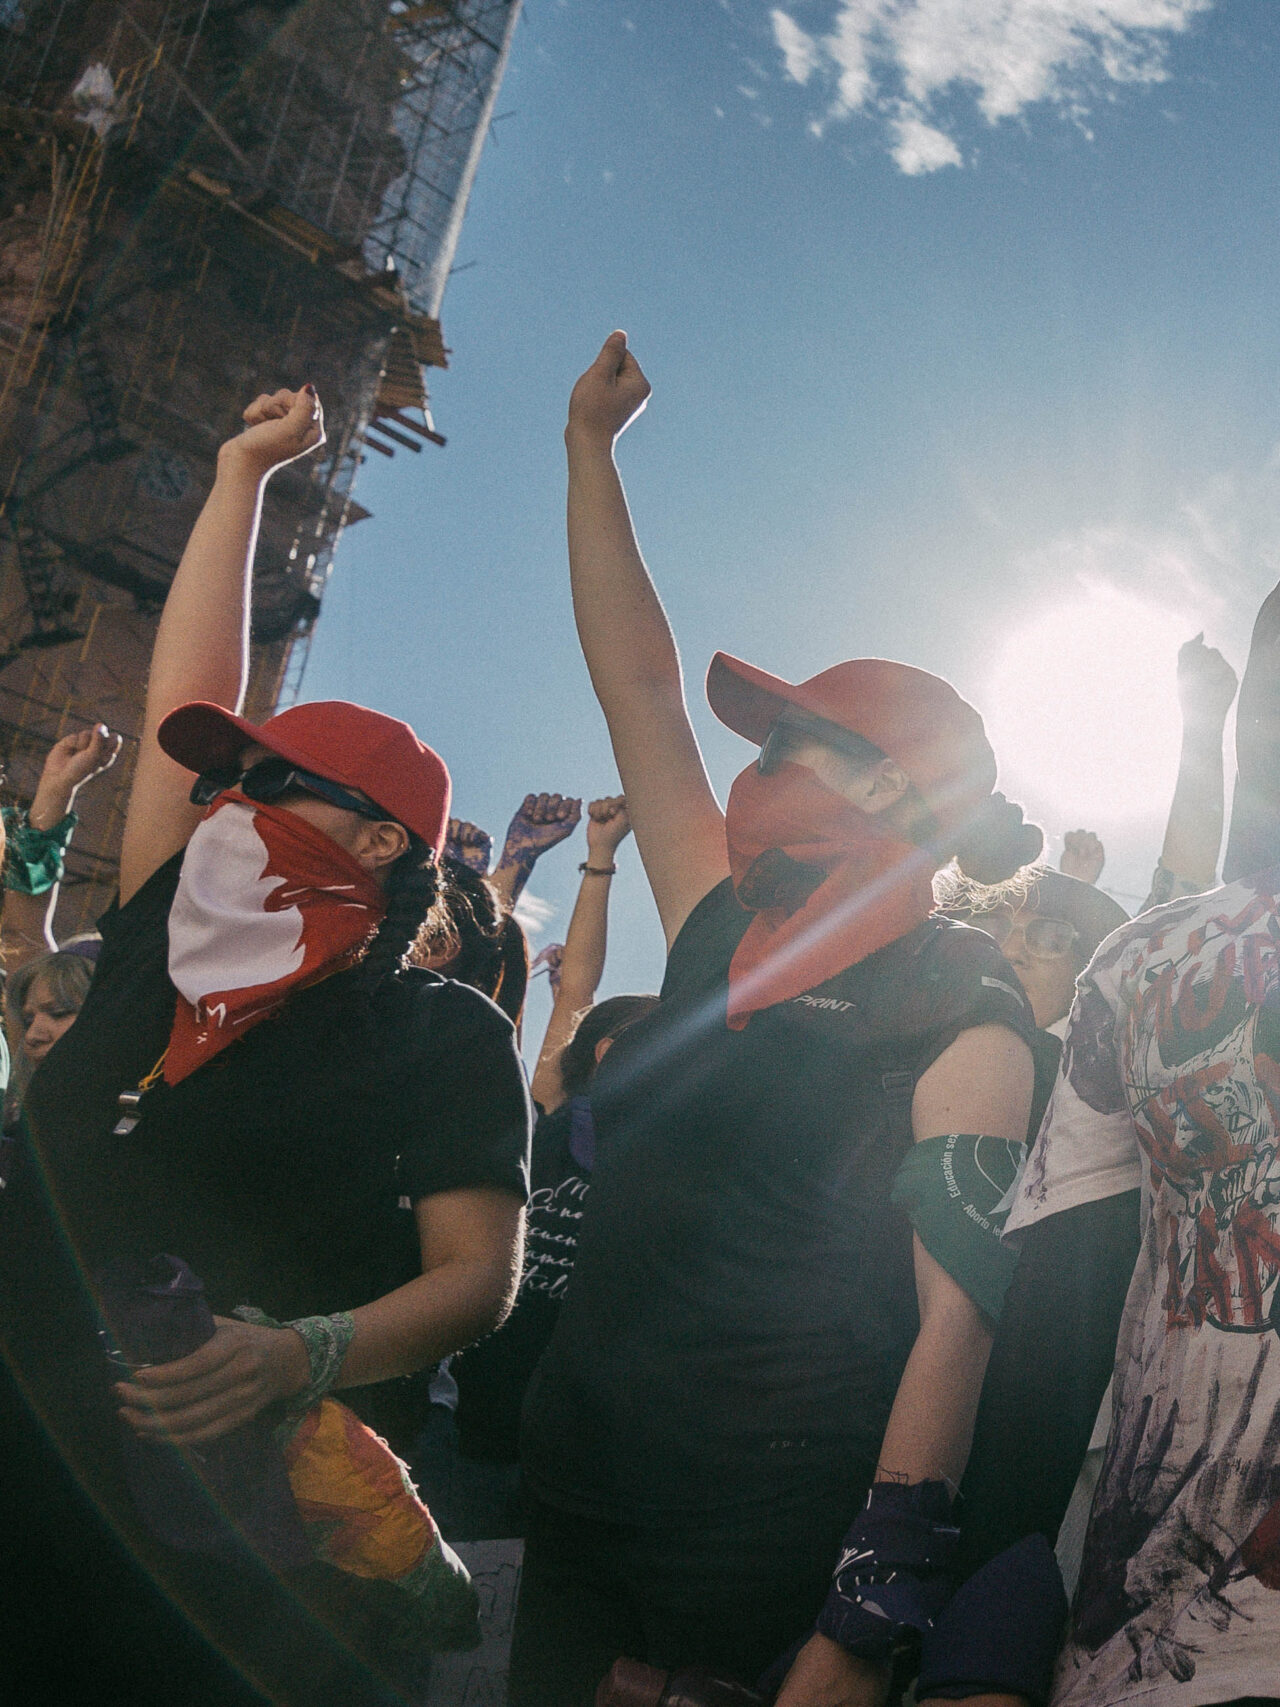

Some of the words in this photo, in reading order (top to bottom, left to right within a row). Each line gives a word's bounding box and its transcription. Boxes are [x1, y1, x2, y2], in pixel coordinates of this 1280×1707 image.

[945, 1134, 960, 1150] sex
[940, 1151, 962, 1199] Educación
[963, 1203, 991, 1230] Aborto
